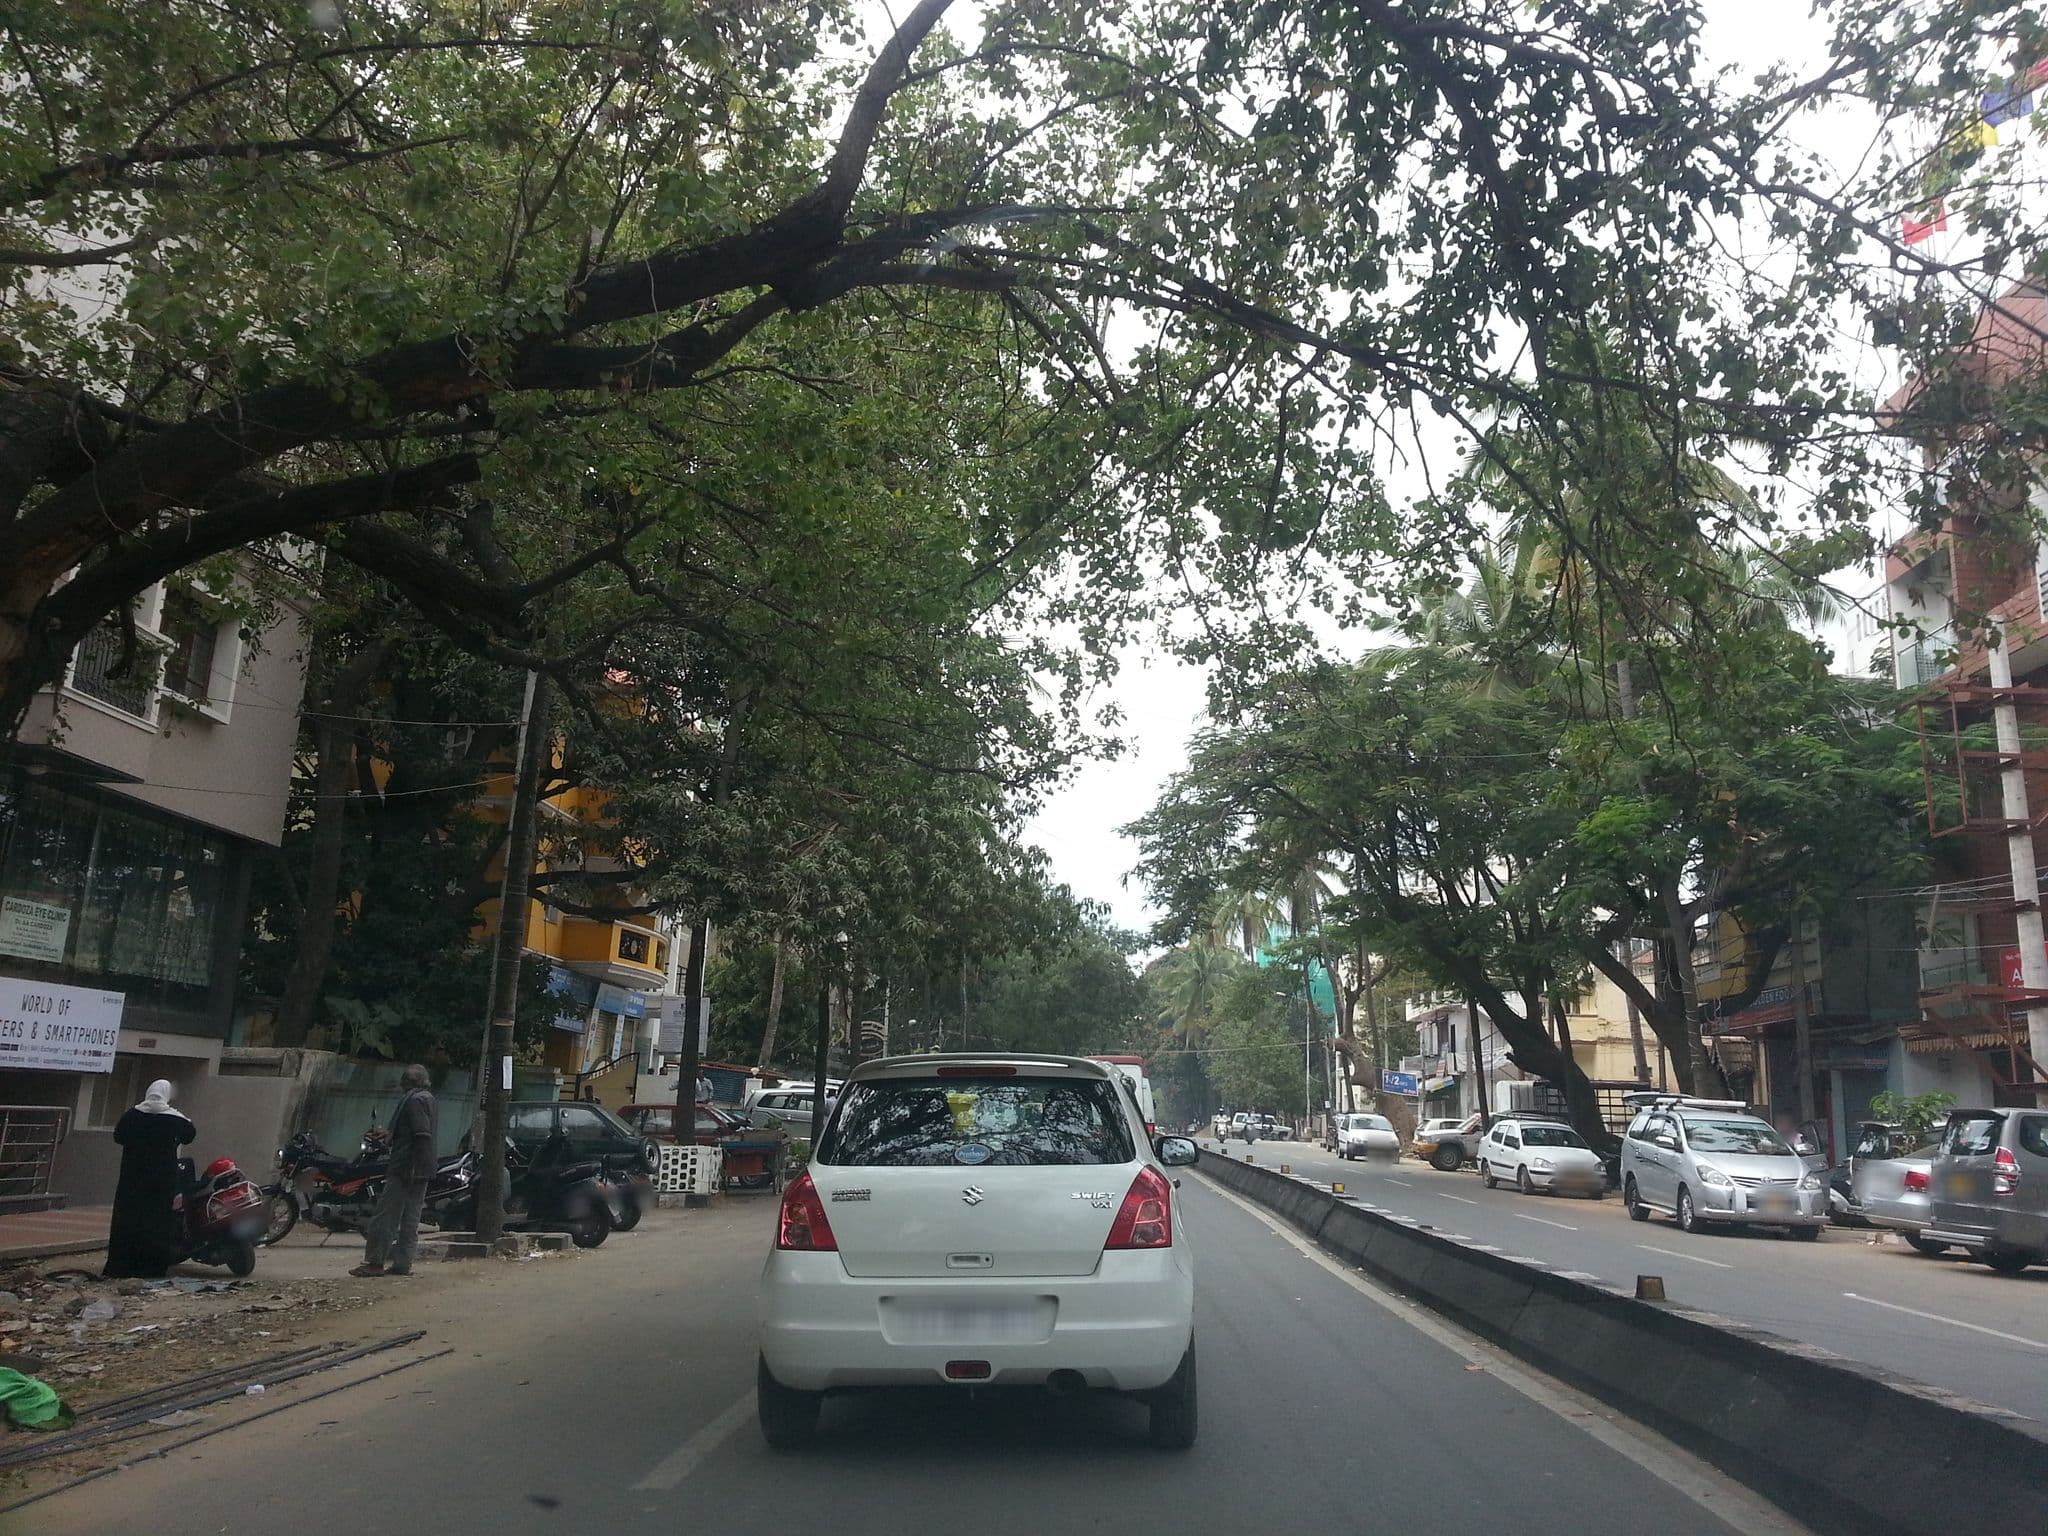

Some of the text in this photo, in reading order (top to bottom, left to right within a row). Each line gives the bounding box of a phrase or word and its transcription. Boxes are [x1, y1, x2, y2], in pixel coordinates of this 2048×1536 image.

[21, 993, 71, 1016] WORLD OF
[31, 1020, 38, 1039] &
[45, 1023, 116, 1046] SMARTPHONES
[1070, 1191, 1116, 1200] SWIFT
